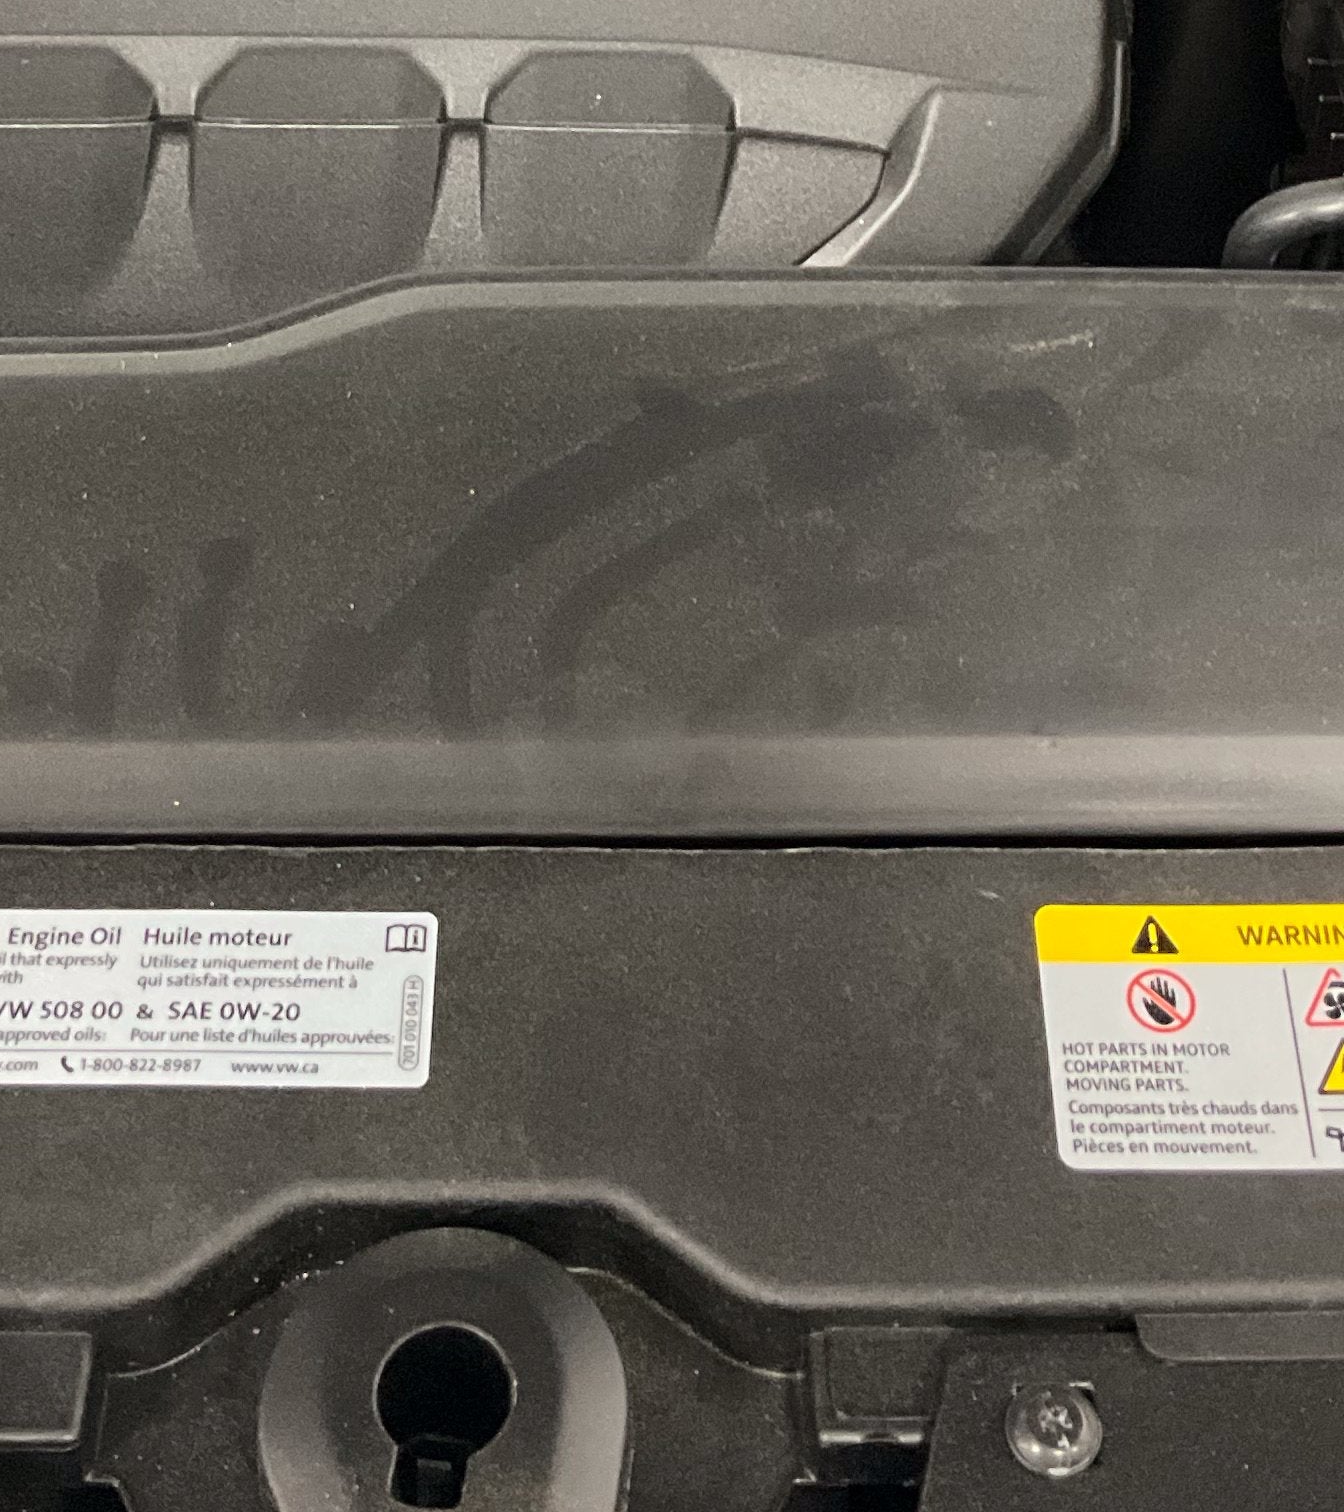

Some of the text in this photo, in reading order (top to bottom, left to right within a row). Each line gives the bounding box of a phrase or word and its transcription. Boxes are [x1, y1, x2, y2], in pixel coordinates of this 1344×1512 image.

[8, 926, 121, 950] Engine Oil
[144, 926, 293, 947] Huile moteur
[11, 953, 42, 966] that
[46, 953, 117, 970] expressly
[141, 955, 374, 974] Utilisez uniquement de l'huile
[137, 973, 344, 991] qui satisfait expressément
[40, 1000, 84, 1019] 508
[92, 1001, 123, 1020] 00
[137, 1004, 154, 1019] &
[168, 1001, 212, 1020] SAE
[220, 1002, 301, 1021] 0W-20
[407, 993, 419, 1018] 043
[74, 1027, 107, 1042] oils:
[130, 1028, 395, 1047] Pour une liste d'huiles approuvées:
[404, 1019, 417, 1043] 010
[1062, 1042, 1231, 1056] HOT PARTS IN MOTOR
[80, 1058, 202, 1072] 1-800-822-8987
[231, 1061, 319, 1074] www.vw.ca
[1064, 1060, 1189, 1074] COMPARTMENT.
[1067, 1077, 1190, 1092] MOVING PARTS.
[1068, 1099, 1298, 1117] Composants très chauds dans
[1090, 1119, 1276, 1137] compartiment moteur.
[1073, 1139, 1258, 1154] Pièces en mouvement.
